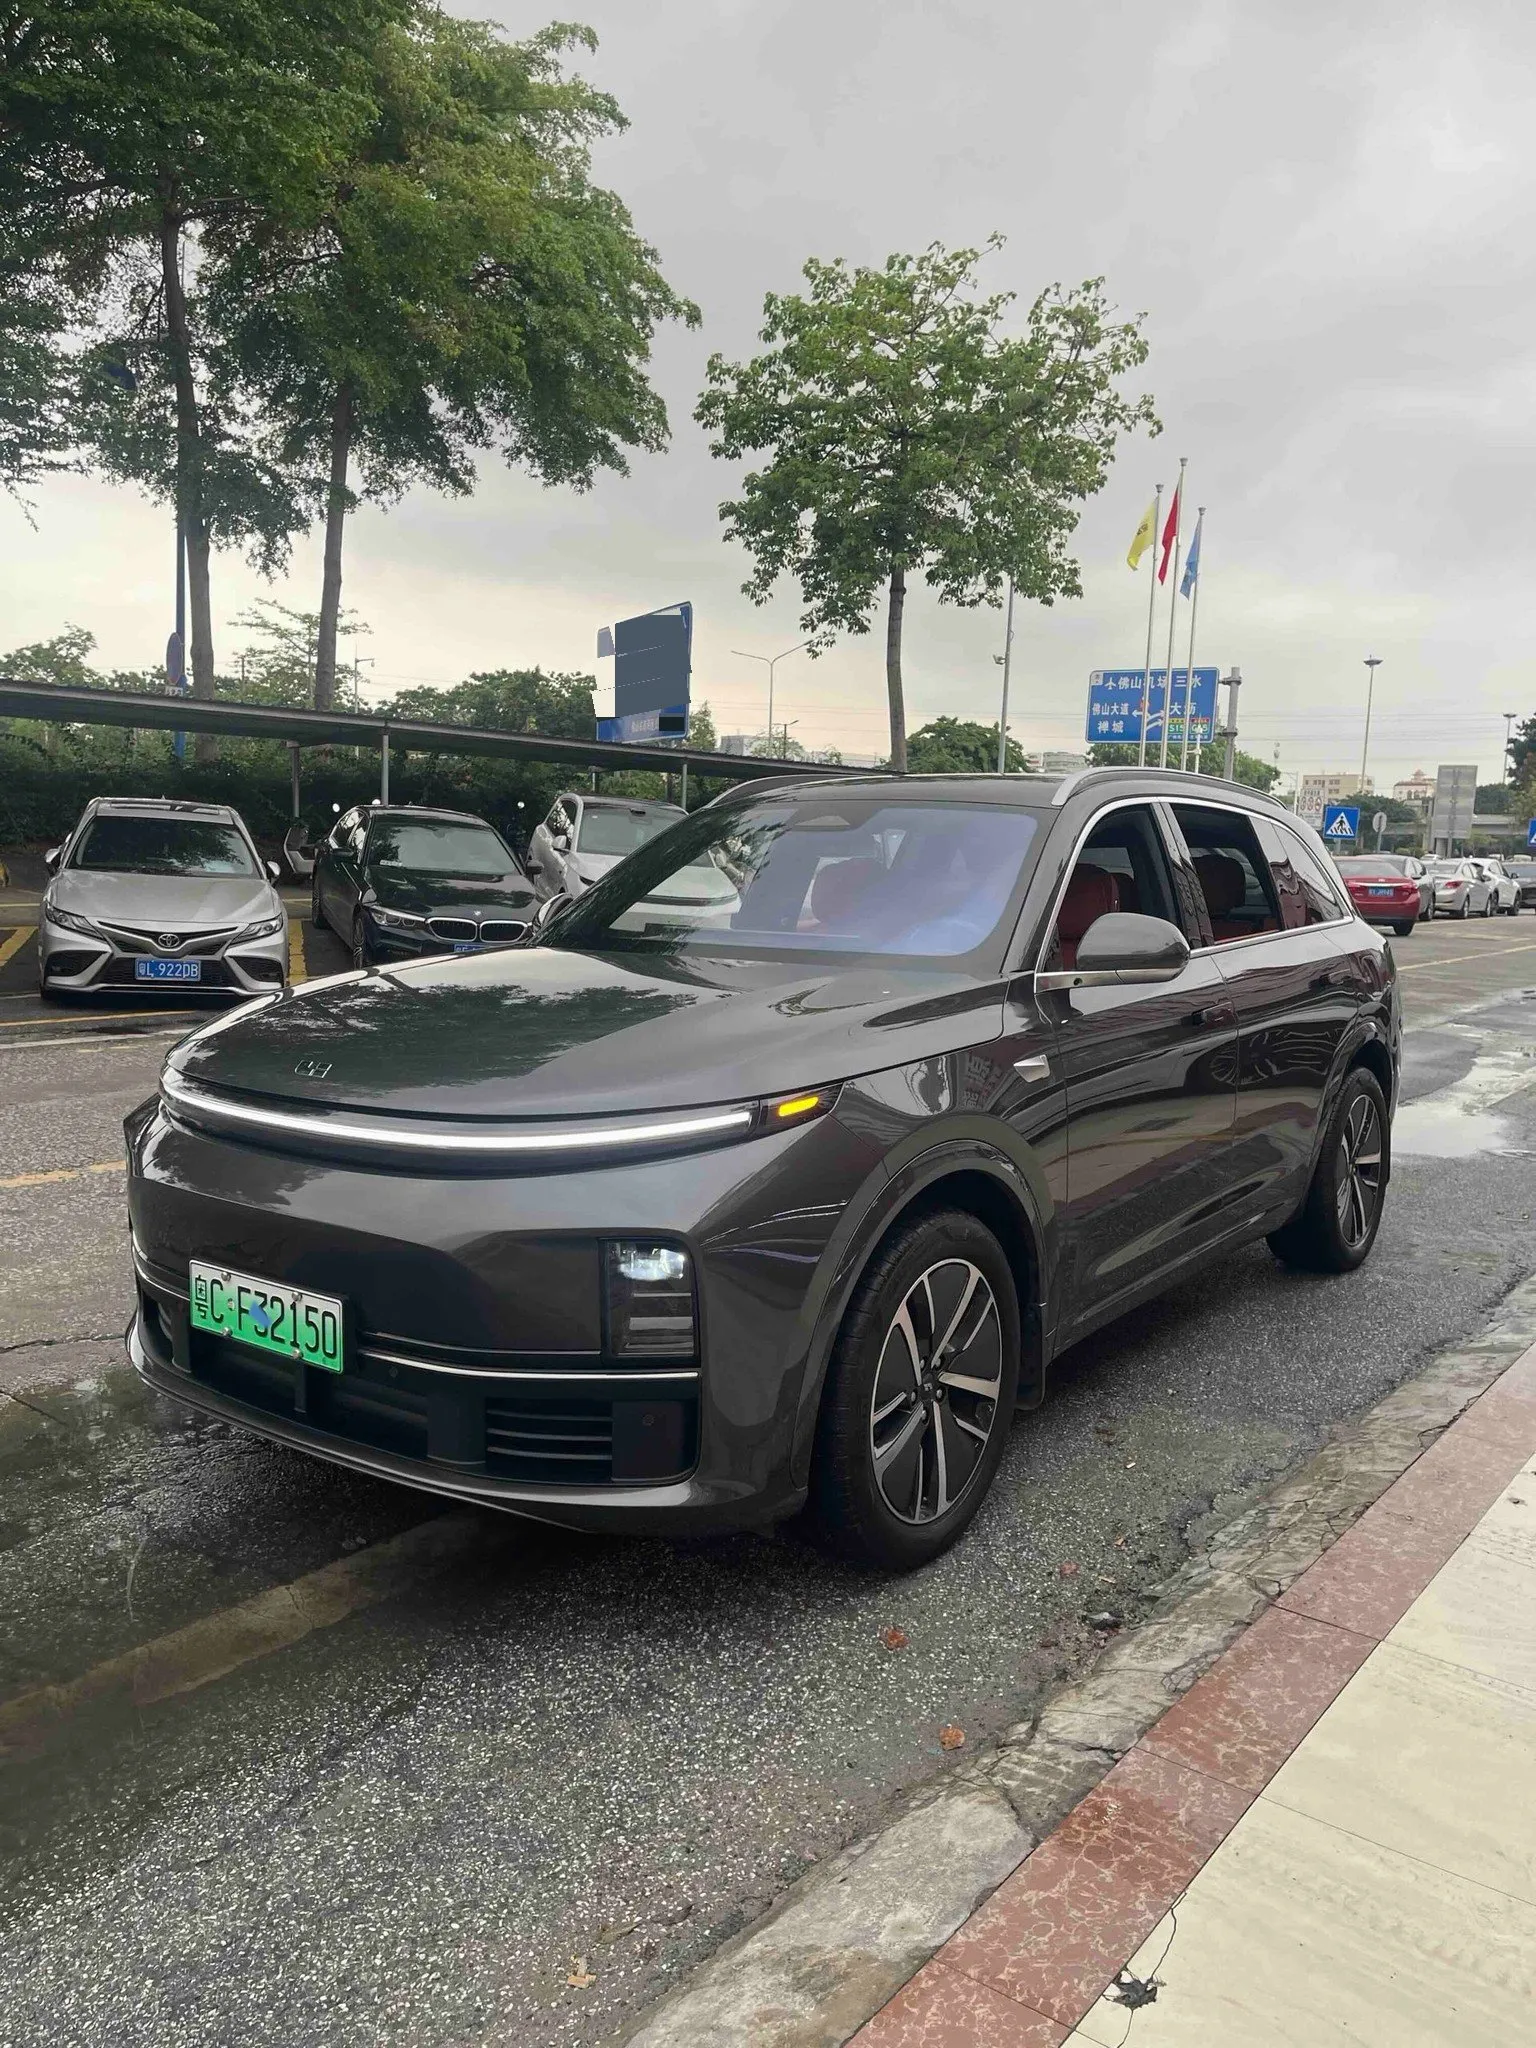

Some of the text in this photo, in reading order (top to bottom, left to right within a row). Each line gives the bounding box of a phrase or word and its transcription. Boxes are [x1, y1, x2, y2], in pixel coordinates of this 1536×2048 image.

[1092, 702, 1129, 716] 佛山大道
[1097, 720, 1124, 734] 禅城
